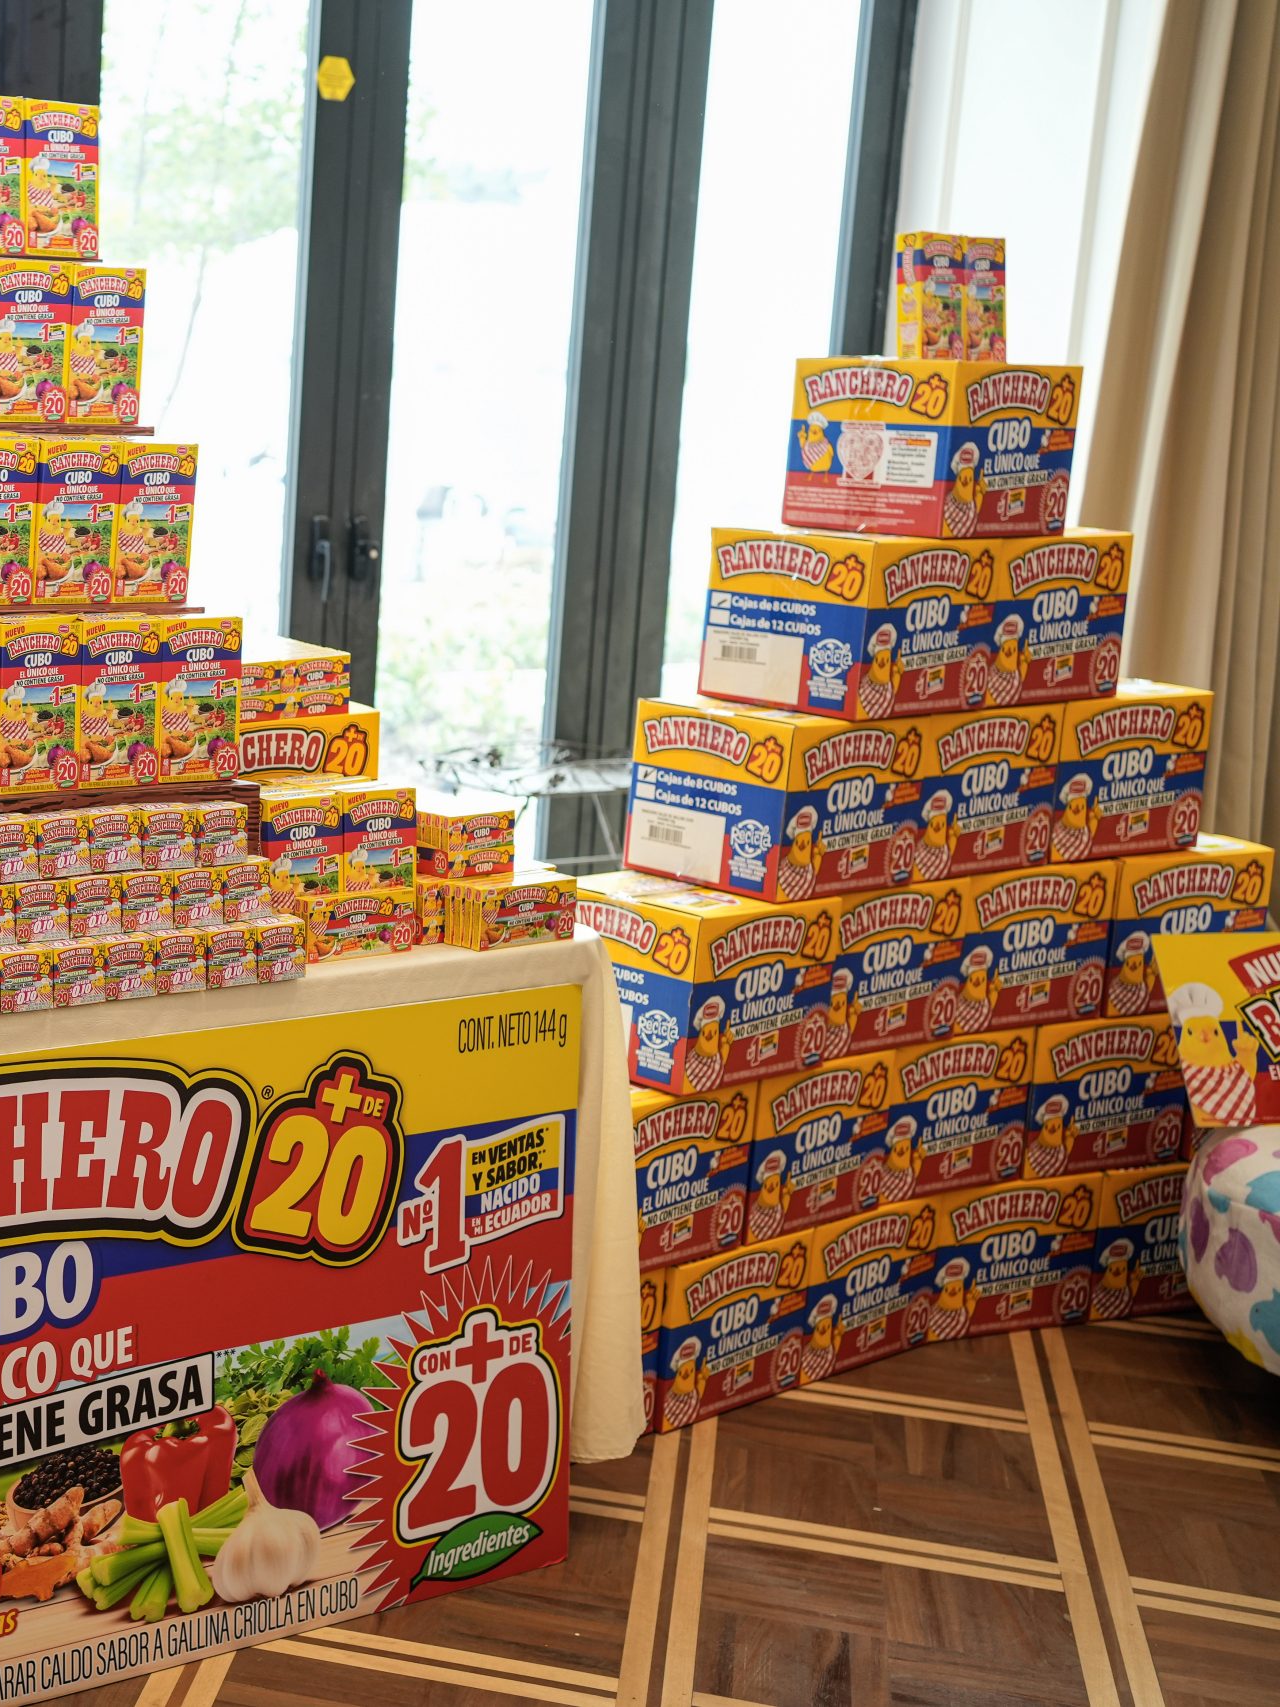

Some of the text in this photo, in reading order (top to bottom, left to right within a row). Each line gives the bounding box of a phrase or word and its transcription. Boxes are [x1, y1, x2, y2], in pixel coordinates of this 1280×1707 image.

[80, 277, 128, 295] RANCHERO
[94, 294, 120, 307] CUBO
[805, 368, 947, 418] RANCHERO 20
[967, 372, 1050, 422] RANCHERO
[987, 418, 1031, 452] CUBO
[984, 450, 1041, 473] EL ÚNICO QUE
[718, 541, 829, 585] RANCHERO
[730, 614, 756, 629] Cajas
[757, 616, 770, 629] de
[772, 618, 784, 631] 12
[784, 620, 821, 636] CUBOS
[732, 596, 758, 610] Cajas
[759, 598, 773, 611] de
[781, 602, 817, 617] CUBOS
[239, 728, 367, 776] CHERO 20
[644, 716, 750, 766] RANCHERO
[805, 730, 896, 788] RANCHERO
[826, 775, 875, 814] CUBO
[272, 807, 325, 833] RANCHERO
[977, 876, 1077, 928] RANCHERO
[1002, 916, 1055, 951] CUBO
[458, 1008, 568, 1053] CONT. NETO 144 g
[363, 1096, 386, 1119] DE
[471, 1128, 545, 1166] EN VENTAS
[250, 1112, 388, 1247] 20
[472, 1173, 483, 1192] Y
[480, 1172, 542, 1214] NACIDO
[418, 1139, 468, 1269] 1
[471, 1192, 552, 1236] EN MI ECUADOR
[687, 1252, 779, 1319] RANCHERO
[710, 1295, 759, 1338] CUBO
[70, 1326, 134, 1380] QUE
[419, 1350, 452, 1377] CON
[509, 1333, 534, 1356] DE
[78, 1365, 205, 1435] GRASA
[408, 1367, 546, 1525] 20
[428, 1522, 532, 1578] Ingredientes
[40, 1645, 94, 1691] CALDO
[95, 1634, 151, 1677] SABOR
[151, 1630, 165, 1662] A
[167, 1614, 231, 1657] GALLINA
[233, 1594, 294, 1640] CRIOLLA
[296, 1593, 317, 1624] EN
[318, 1577, 360, 1619] CUBO
